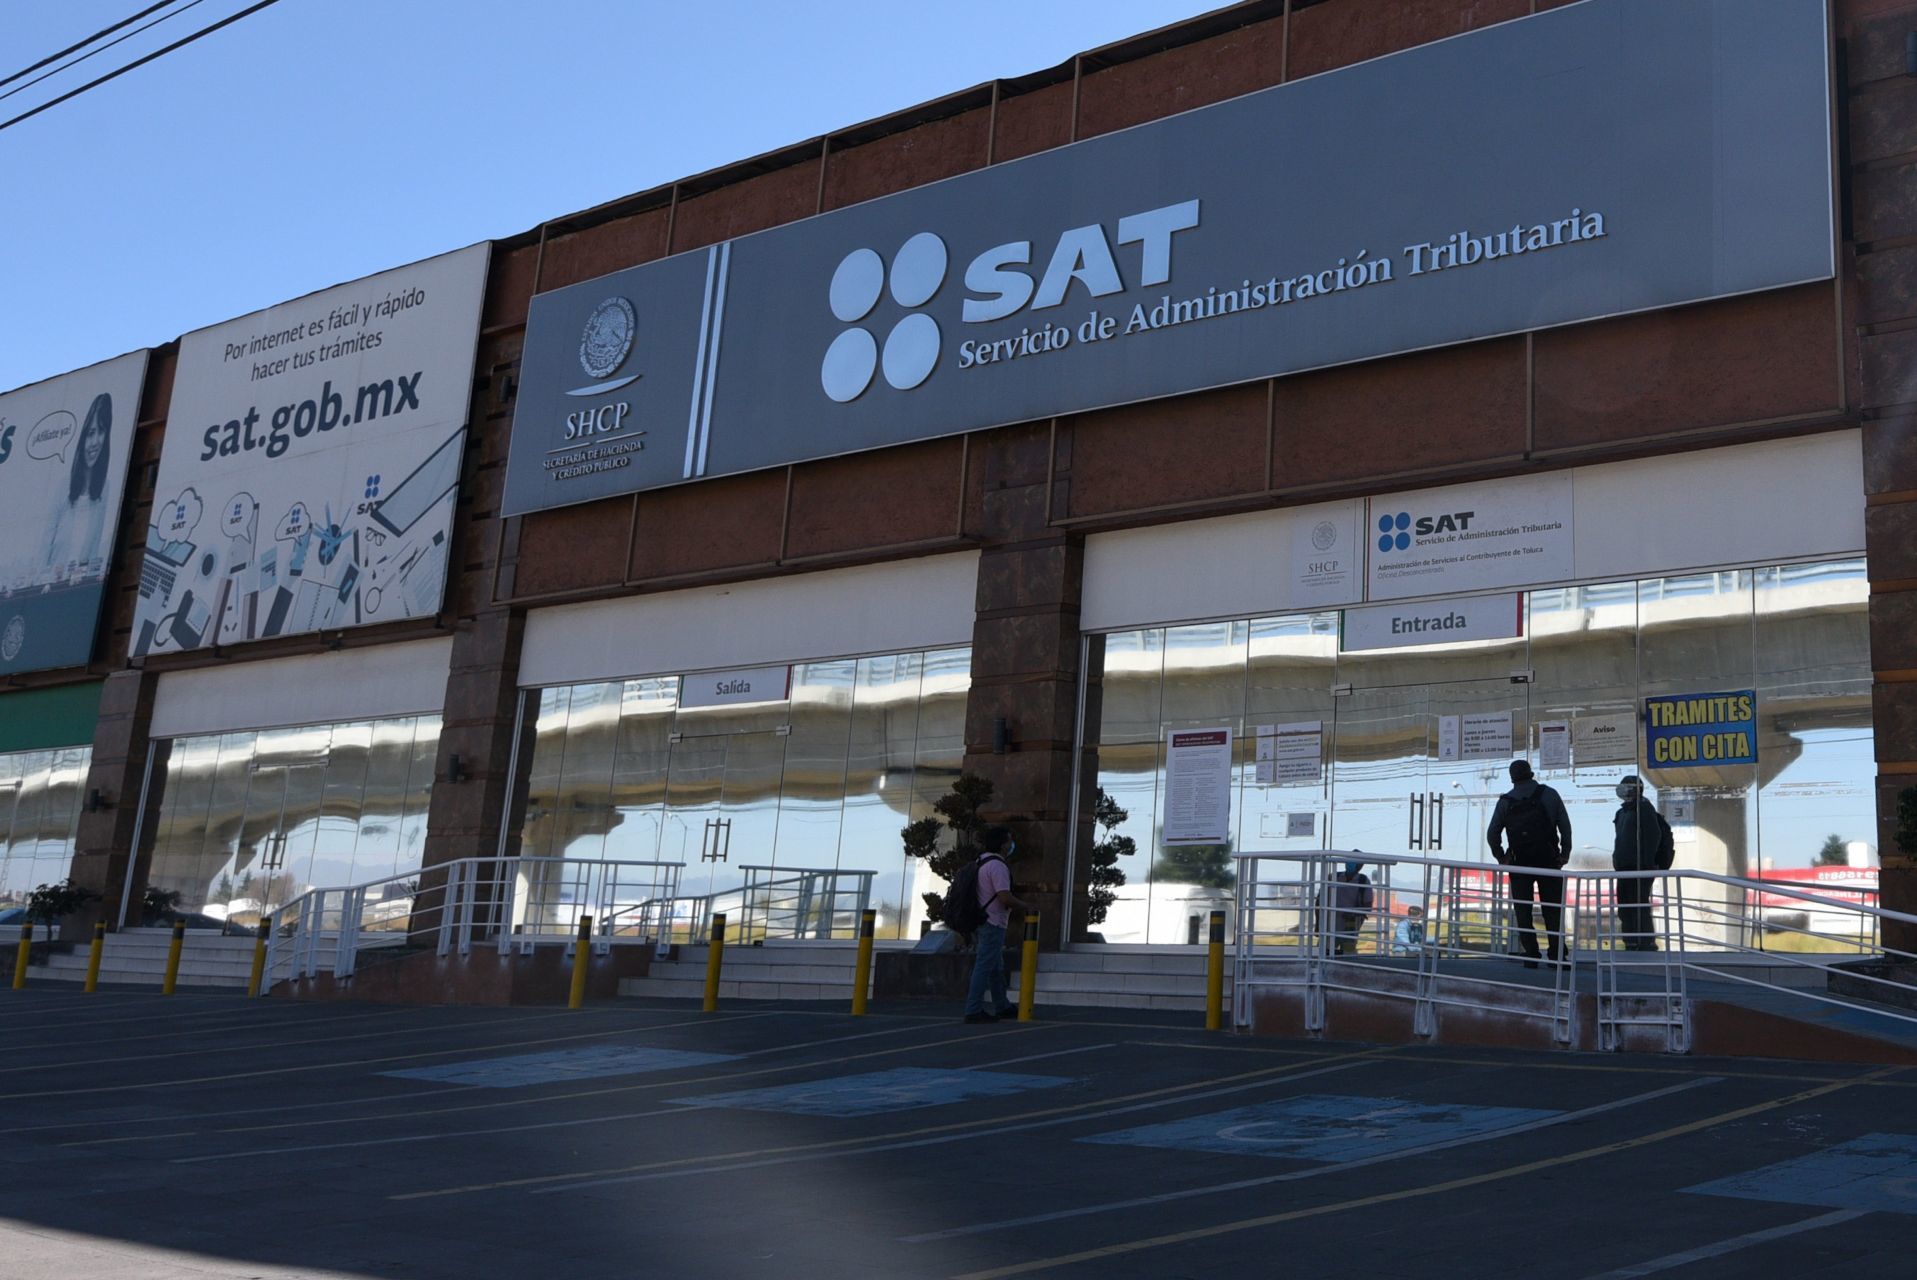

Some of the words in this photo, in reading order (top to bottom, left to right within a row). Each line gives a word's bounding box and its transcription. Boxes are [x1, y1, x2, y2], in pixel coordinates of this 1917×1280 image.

[962, 198, 1200, 323] SAT
[959, 322, 1070, 369] Servicio
[1076, 306, 1116, 346] de
[1124, 247, 1395, 334] Administración
[1403, 208, 1607, 277] Tributaria
[224, 342, 247, 362] Por
[249, 323, 304, 355] internet
[308, 318, 324, 337] es
[328, 303, 359, 332] fácil
[362, 304, 372, 327] y
[375, 286, 425, 319] rápido
[251, 357, 290, 382] hacer
[293, 349, 315, 370] tus
[319, 330, 383, 362] trámites
[200, 371, 423, 462] sat.gob.mx
[565, 401, 629, 440] SHCP
[543, 451, 586, 470] SECRETARÍA
[588, 449, 599, 461] DE
[600, 441, 643, 459] HACIENDA
[170, 520, 187, 531] SAT
[229, 515, 243, 525] SAT
[285, 525, 303, 535] SAT
[1415, 511, 1475, 536] SAT
[1415, 535, 1445, 547] Servicio
[1446, 534, 1456, 543] de
[1458, 526, 1519, 541] Administración
[1521, 521, 1562, 533] Tributaria
[1308, 561, 1339, 574] SHCP
[1377, 559, 1422, 571] Administración
[1423, 558, 1431, 566] de
[1431, 556, 1458, 565] Servicios
[1459, 554, 1466, 562] al
[1466, 549, 1512, 561] Contribuyente
[1512, 548, 1521, 556] de
[1522, 546, 1544, 555] Toluca
[1391, 611, 1467, 634] Entrada
[715, 679, 751, 695] Salida
[1648, 695, 1752, 727] TRAMITES
[1593, 725, 1616, 733] Aviso
[1654, 735, 1697, 763] CON
[1702, 732, 1750, 760] CITA
